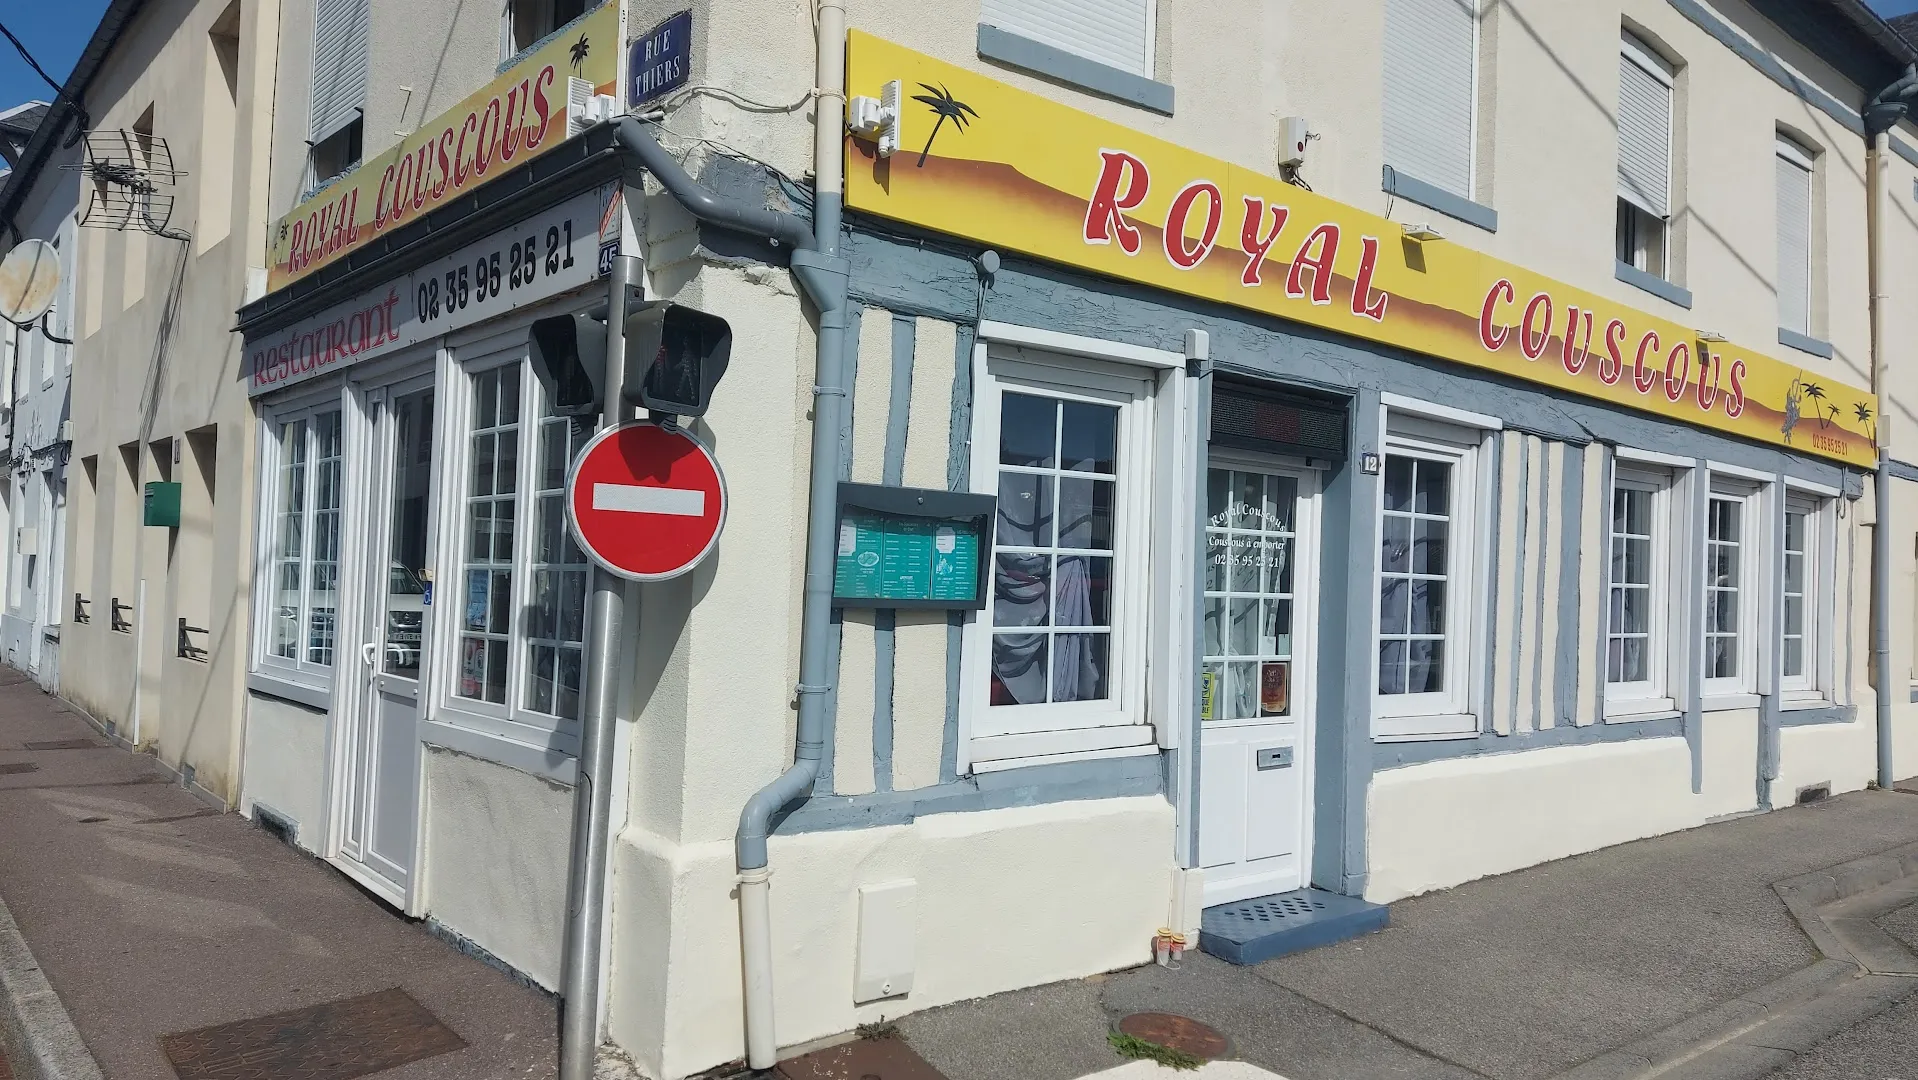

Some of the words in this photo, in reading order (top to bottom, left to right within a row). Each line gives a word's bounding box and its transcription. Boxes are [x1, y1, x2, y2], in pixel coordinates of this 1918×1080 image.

[645, 29, 671, 62] RUE
[635, 55, 680, 97] THIERS
[287, 186, 360, 276] ROYAL
[375, 65, 554, 231] COUSCOUS
[417, 277, 440, 324] 02
[445, 267, 469, 315] 35
[475, 252, 501, 303] 95
[508, 234, 537, 290] 25
[544, 218, 575, 277] 21
[1082, 148, 1389, 323] ROYAL
[1478, 277, 1748, 420] COUSCOUS
[1365, 455, 1377, 472] 12
[1210, 502, 1241, 527] Royal
[1242, 503, 1286, 532] Couscous
[1208, 535, 1245, 548] Cousous
[1246, 537, 1252, 548] à
[1215, 553, 1227, 565] 02
[1241, 555, 1253, 567] 95
[1268, 557, 1279, 568] 21
